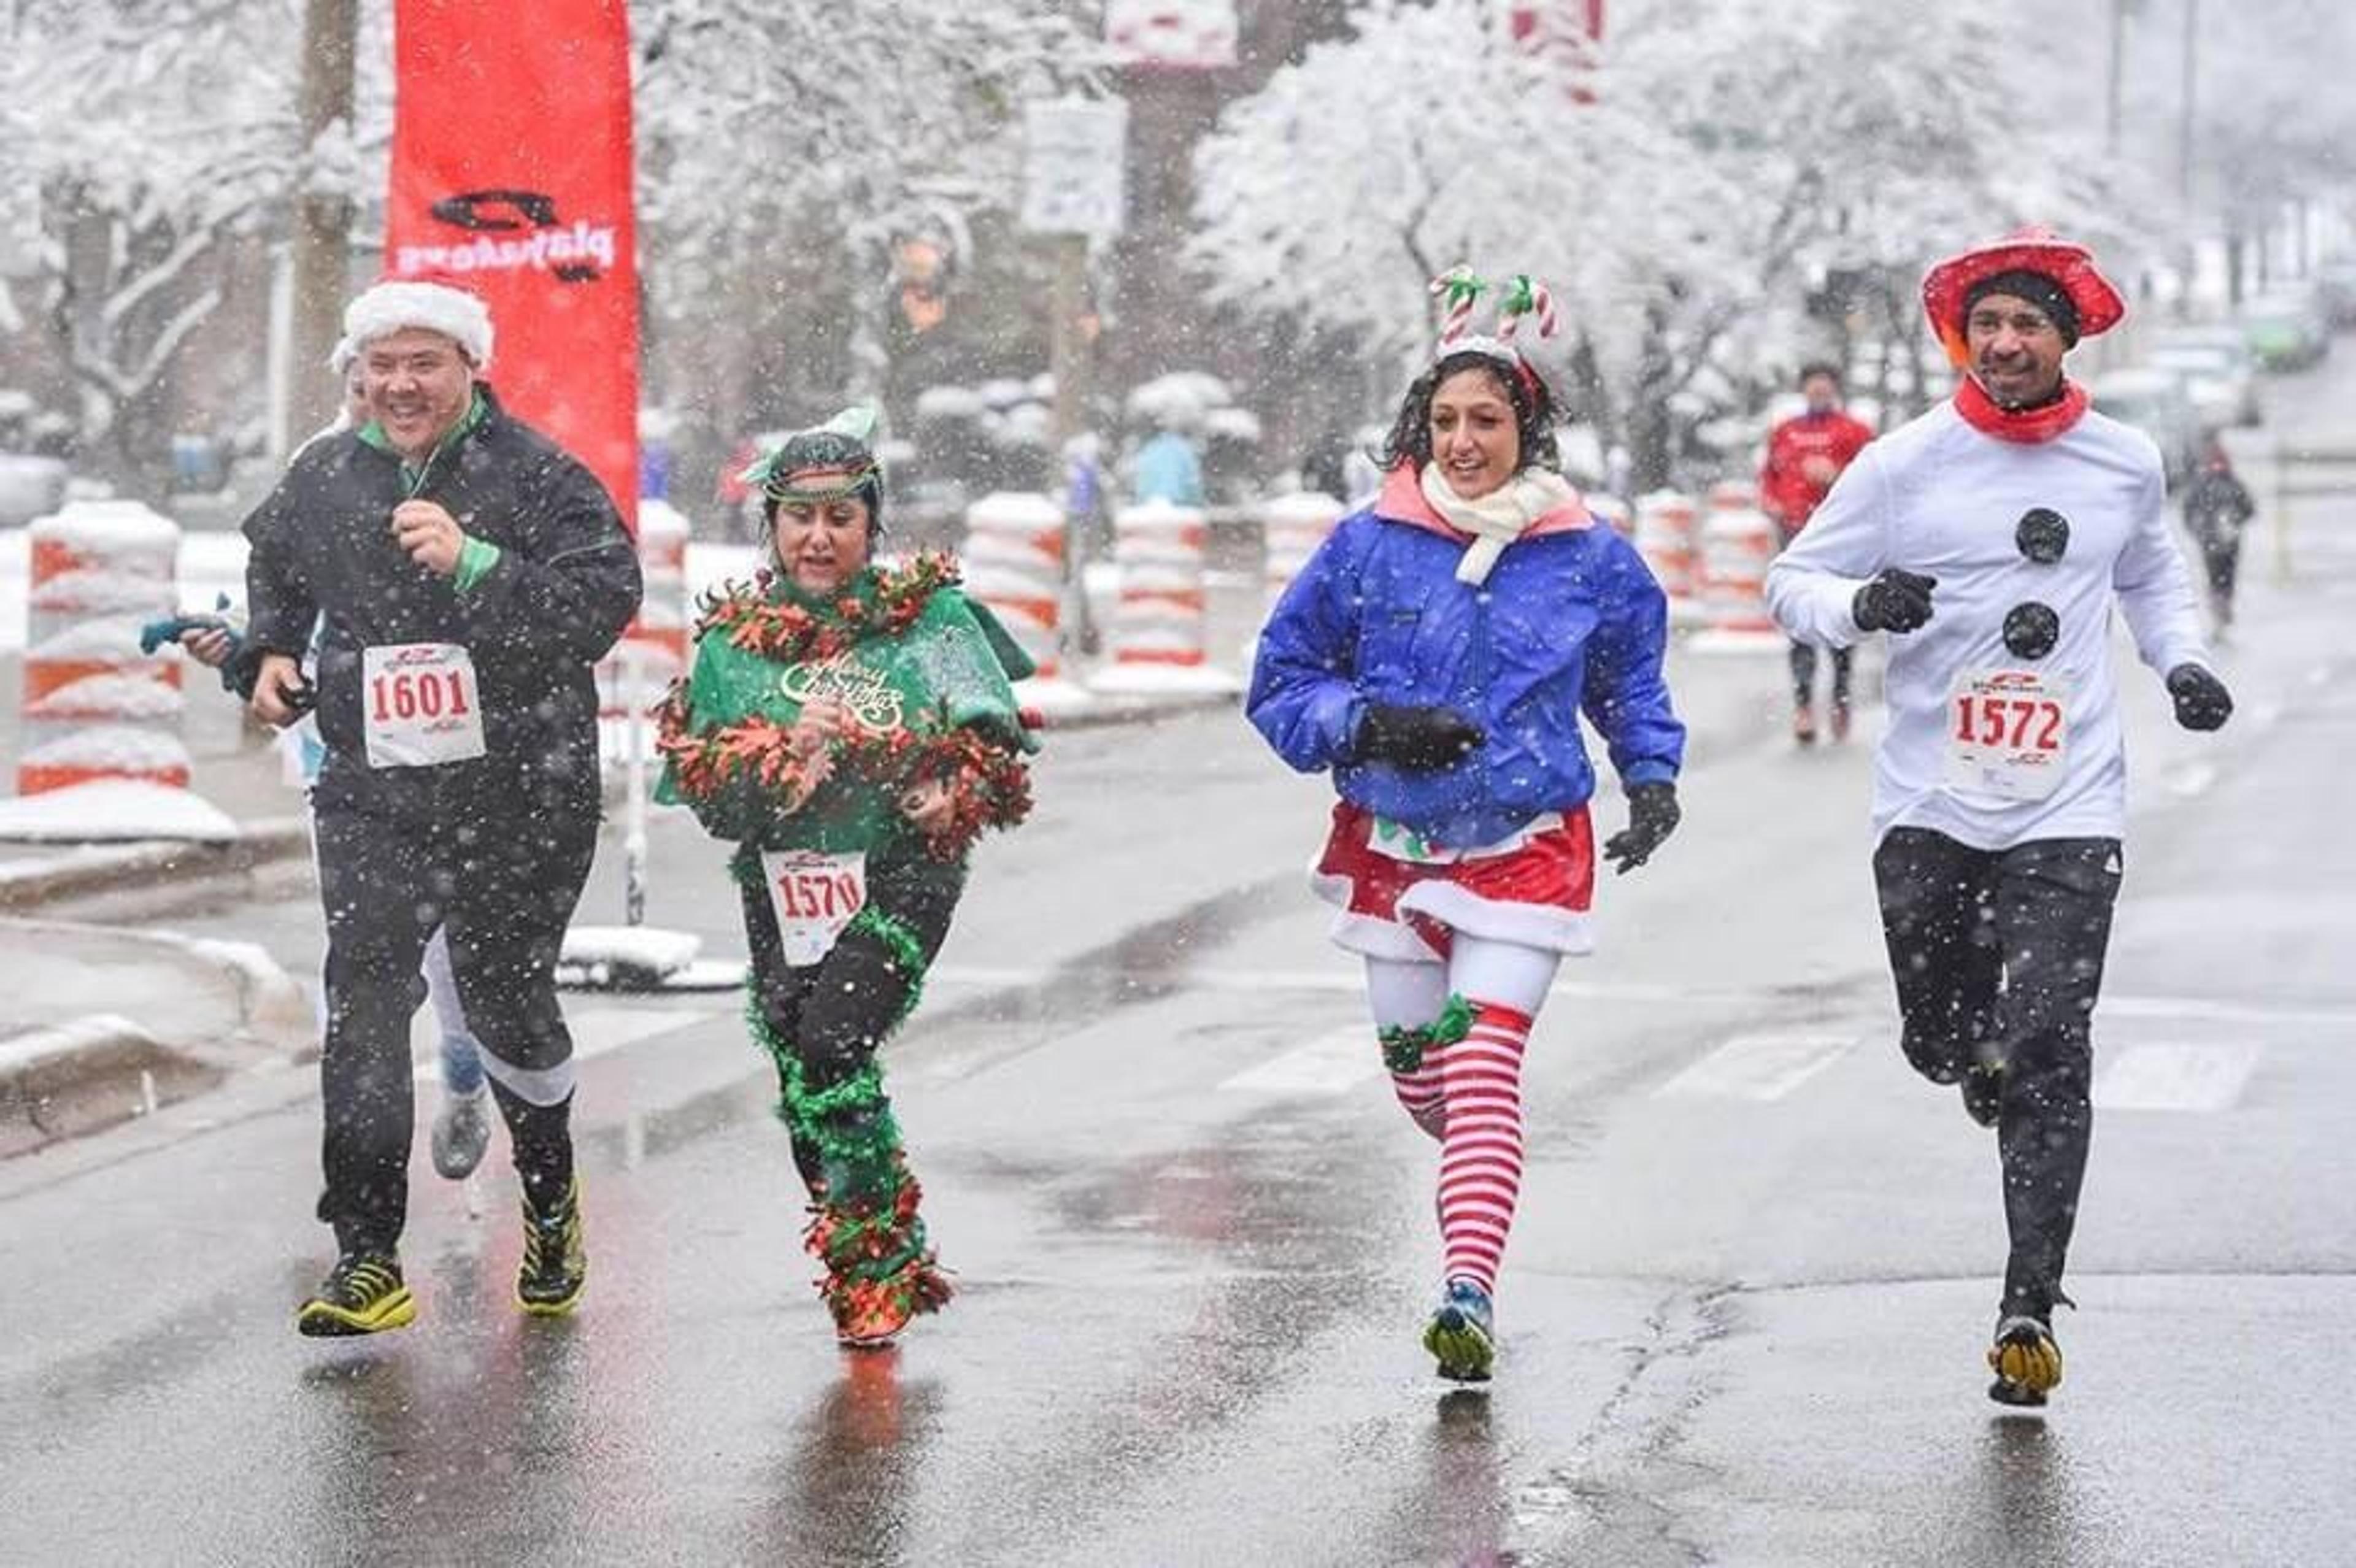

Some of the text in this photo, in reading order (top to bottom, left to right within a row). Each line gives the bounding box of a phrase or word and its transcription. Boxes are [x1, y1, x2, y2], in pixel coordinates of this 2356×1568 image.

[372, 669, 468, 721] 1601
[1958, 696, 2061, 749] 1572
[779, 873, 860, 917] 1570
